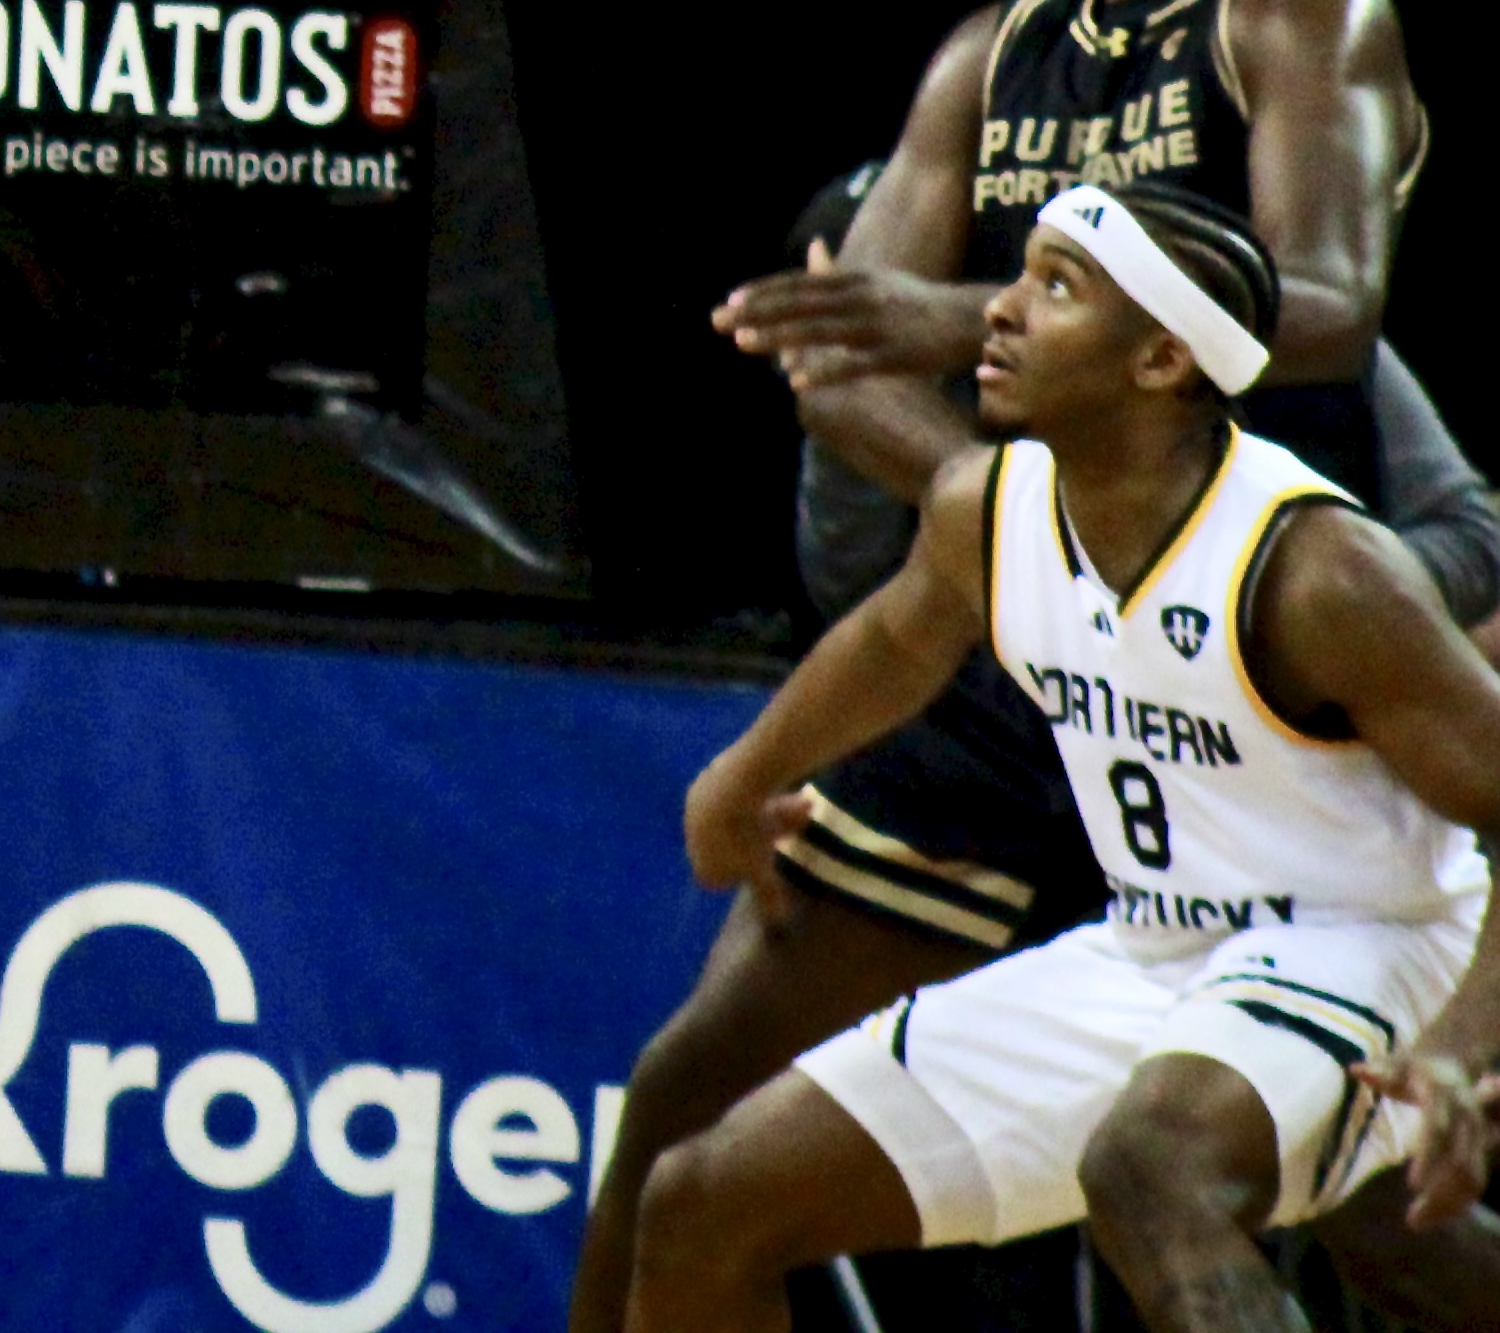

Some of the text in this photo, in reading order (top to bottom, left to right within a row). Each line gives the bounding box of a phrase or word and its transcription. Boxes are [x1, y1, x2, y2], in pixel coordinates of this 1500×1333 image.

[3, 133, 122, 178] piece
[134, 137, 170, 175] is
[1108, 758, 1171, 870] 8
